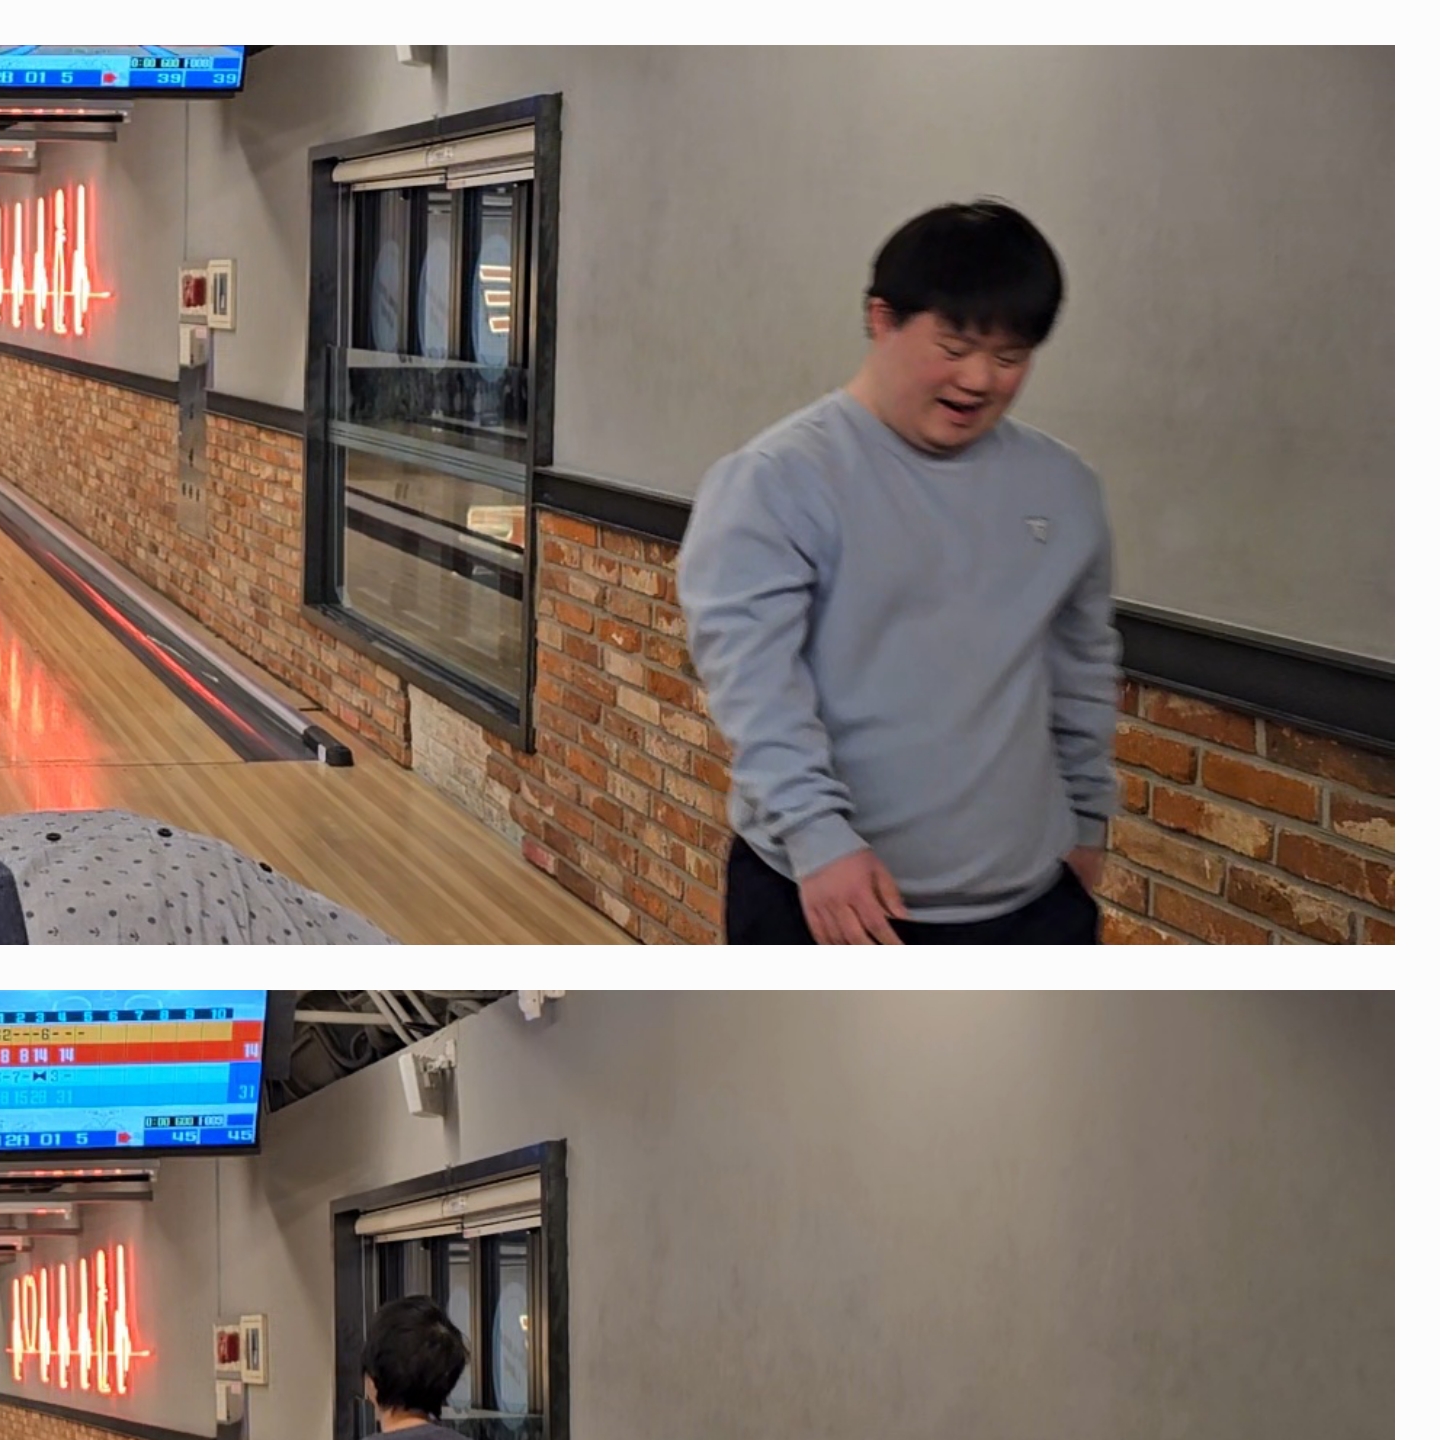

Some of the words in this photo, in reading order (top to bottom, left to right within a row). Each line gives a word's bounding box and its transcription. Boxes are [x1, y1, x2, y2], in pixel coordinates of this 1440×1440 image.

[25, 71, 46, 83] 01
[61, 71, 73, 83] 5
[158, 73, 181, 83] 39
[213, 74, 236, 83] 39
[244, 1044, 258, 1057] 14
[239, 1085, 255, 1098] 31
[40, 1134, 60, 1145] 01
[76, 1134, 87, 1145] 5
[173, 1131, 195, 1142] 45
[228, 1130, 251, 1141] 45
